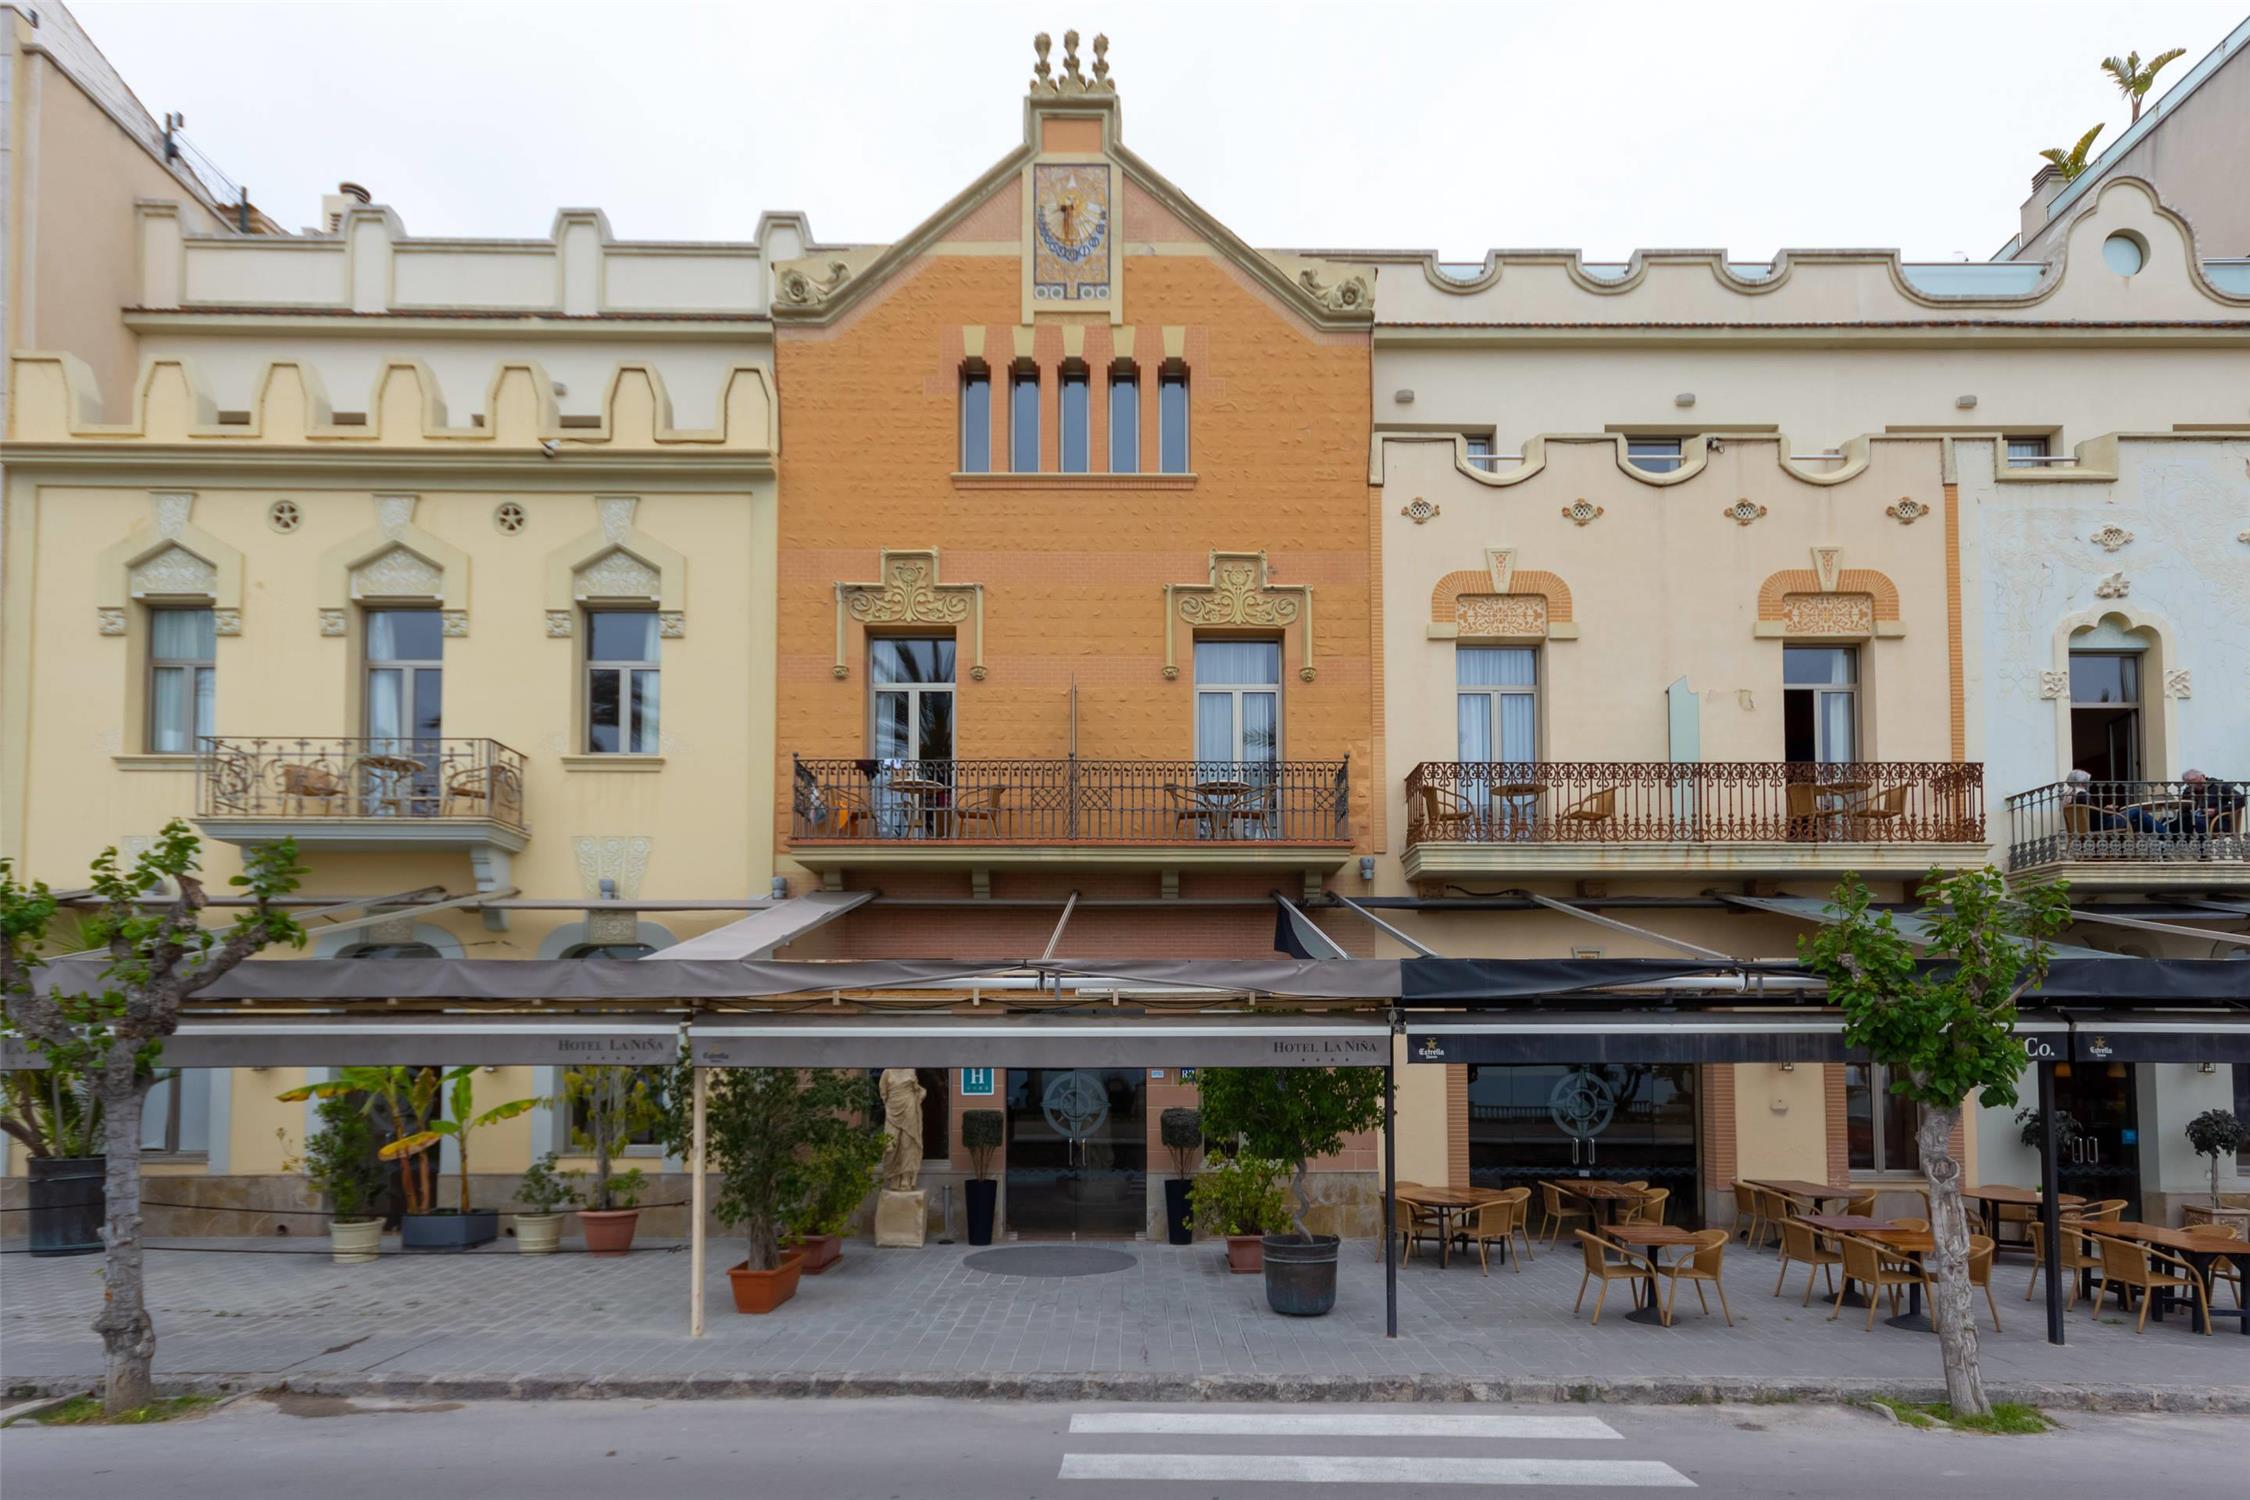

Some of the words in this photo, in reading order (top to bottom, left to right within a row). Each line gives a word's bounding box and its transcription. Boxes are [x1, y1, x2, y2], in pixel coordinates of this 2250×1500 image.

[558, 1039, 602, 1051] HOTEL
[1273, 1041, 1318, 1053] HOTEL
[2024, 1037, 2055, 1056] Co.
[1418, 1048, 1445, 1056] Estrella
[971, 1067, 984, 1084] H
